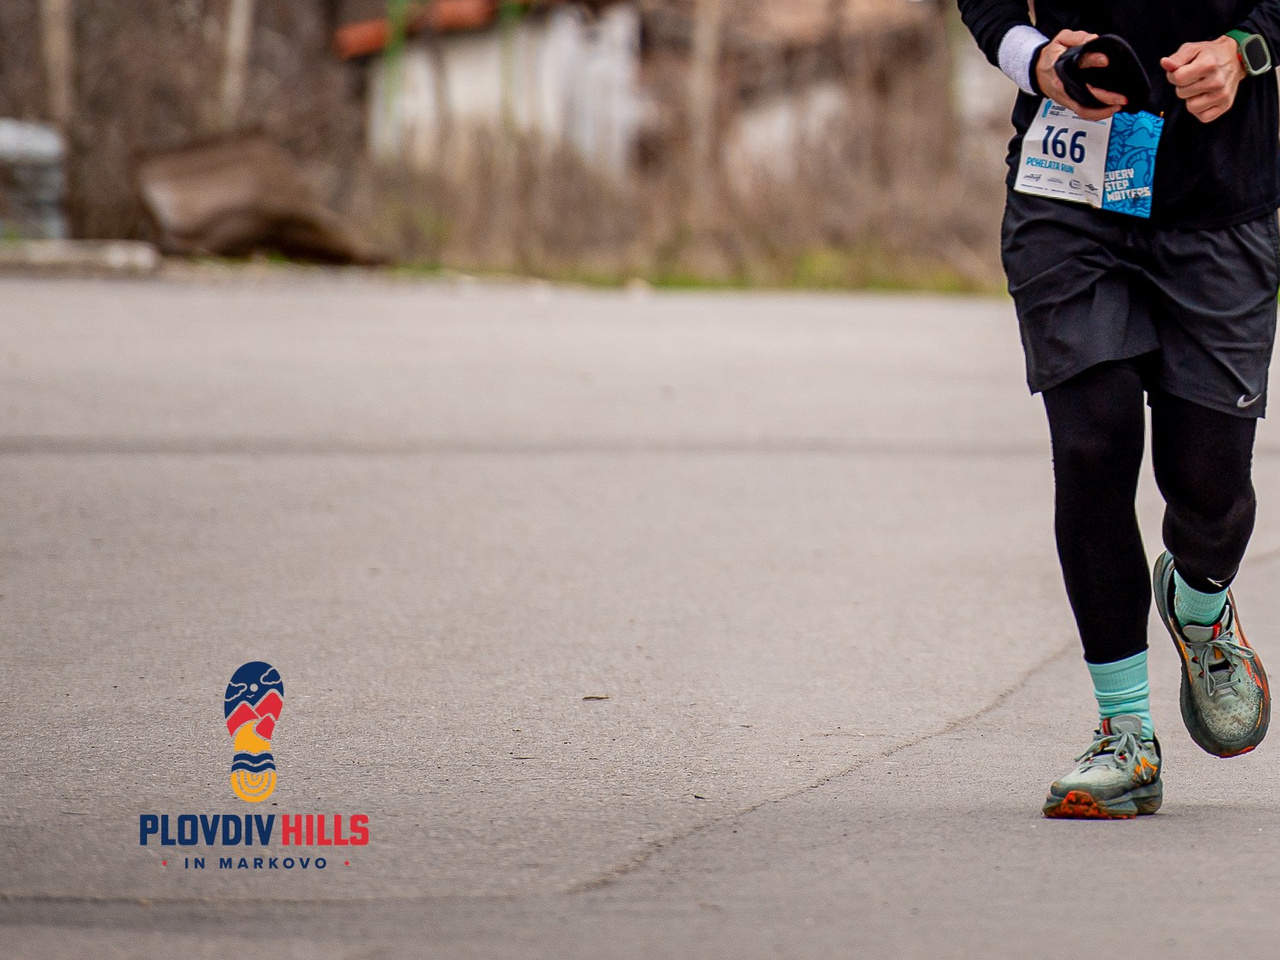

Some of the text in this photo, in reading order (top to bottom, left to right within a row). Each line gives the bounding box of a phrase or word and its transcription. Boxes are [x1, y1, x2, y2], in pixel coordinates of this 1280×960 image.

[1042, 125, 1087, 163] 166
[1061, 163, 1075, 174] RUN
[1104, 168, 1135, 181] EVERY
[1104, 179, 1129, 191] STEP
